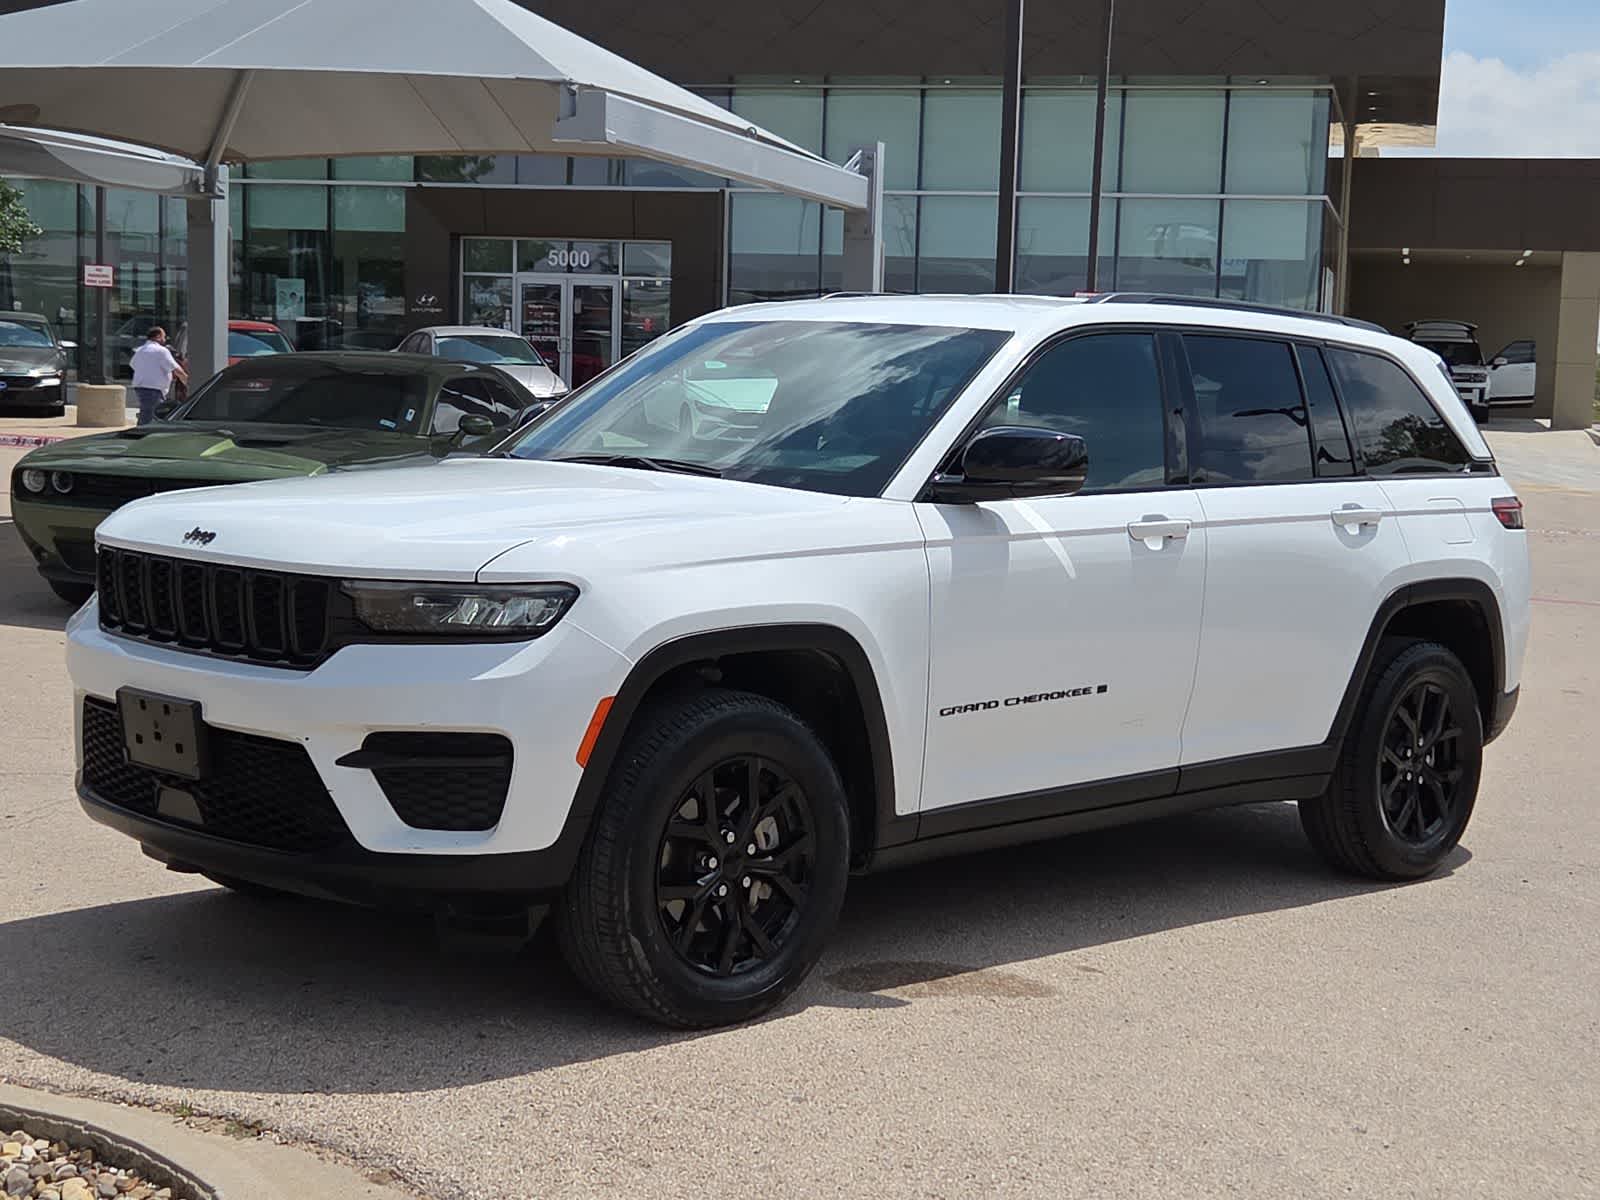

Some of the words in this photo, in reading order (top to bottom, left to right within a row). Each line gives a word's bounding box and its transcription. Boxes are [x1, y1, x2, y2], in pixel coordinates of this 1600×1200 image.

[548, 250, 590, 268] 5000
[184, 526, 217, 545] Jeep
[939, 700, 999, 716] GRAND
[1004, 686, 1093, 706] CHEROKEE
